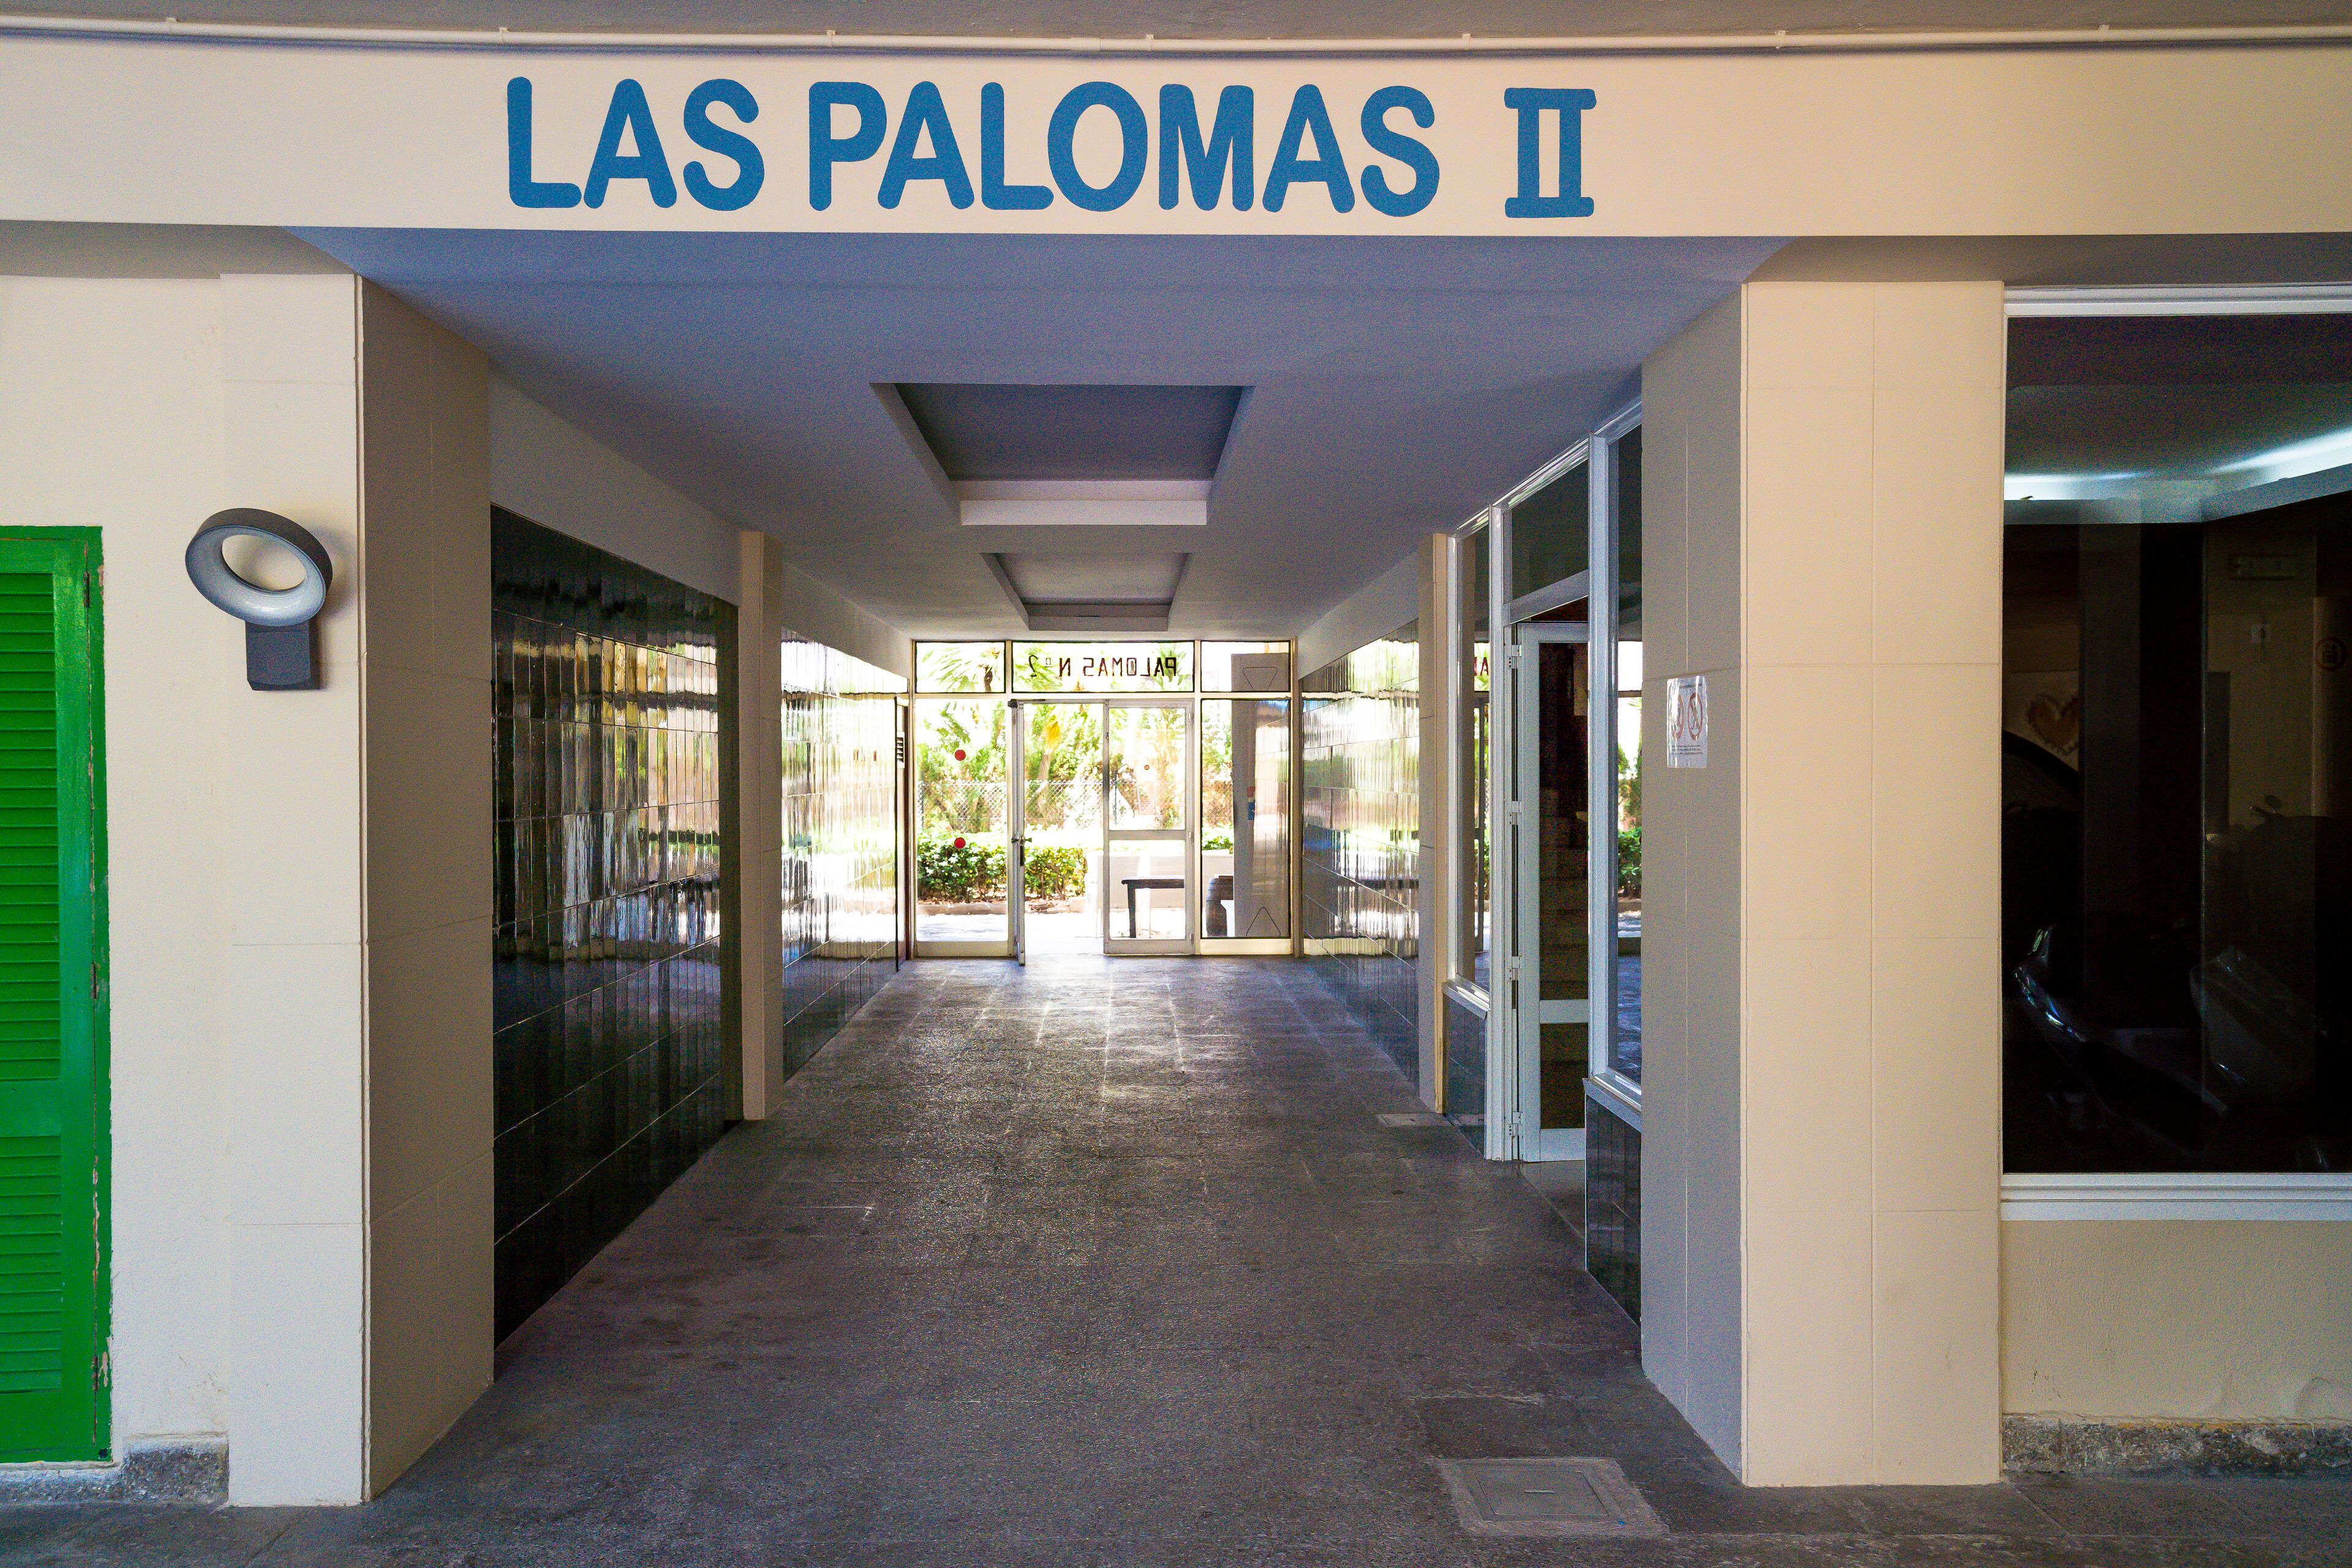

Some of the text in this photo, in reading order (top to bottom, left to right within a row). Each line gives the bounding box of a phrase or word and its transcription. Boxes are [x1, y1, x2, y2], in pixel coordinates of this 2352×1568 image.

[508, 77, 1596, 217] LAS PALOMAS II
